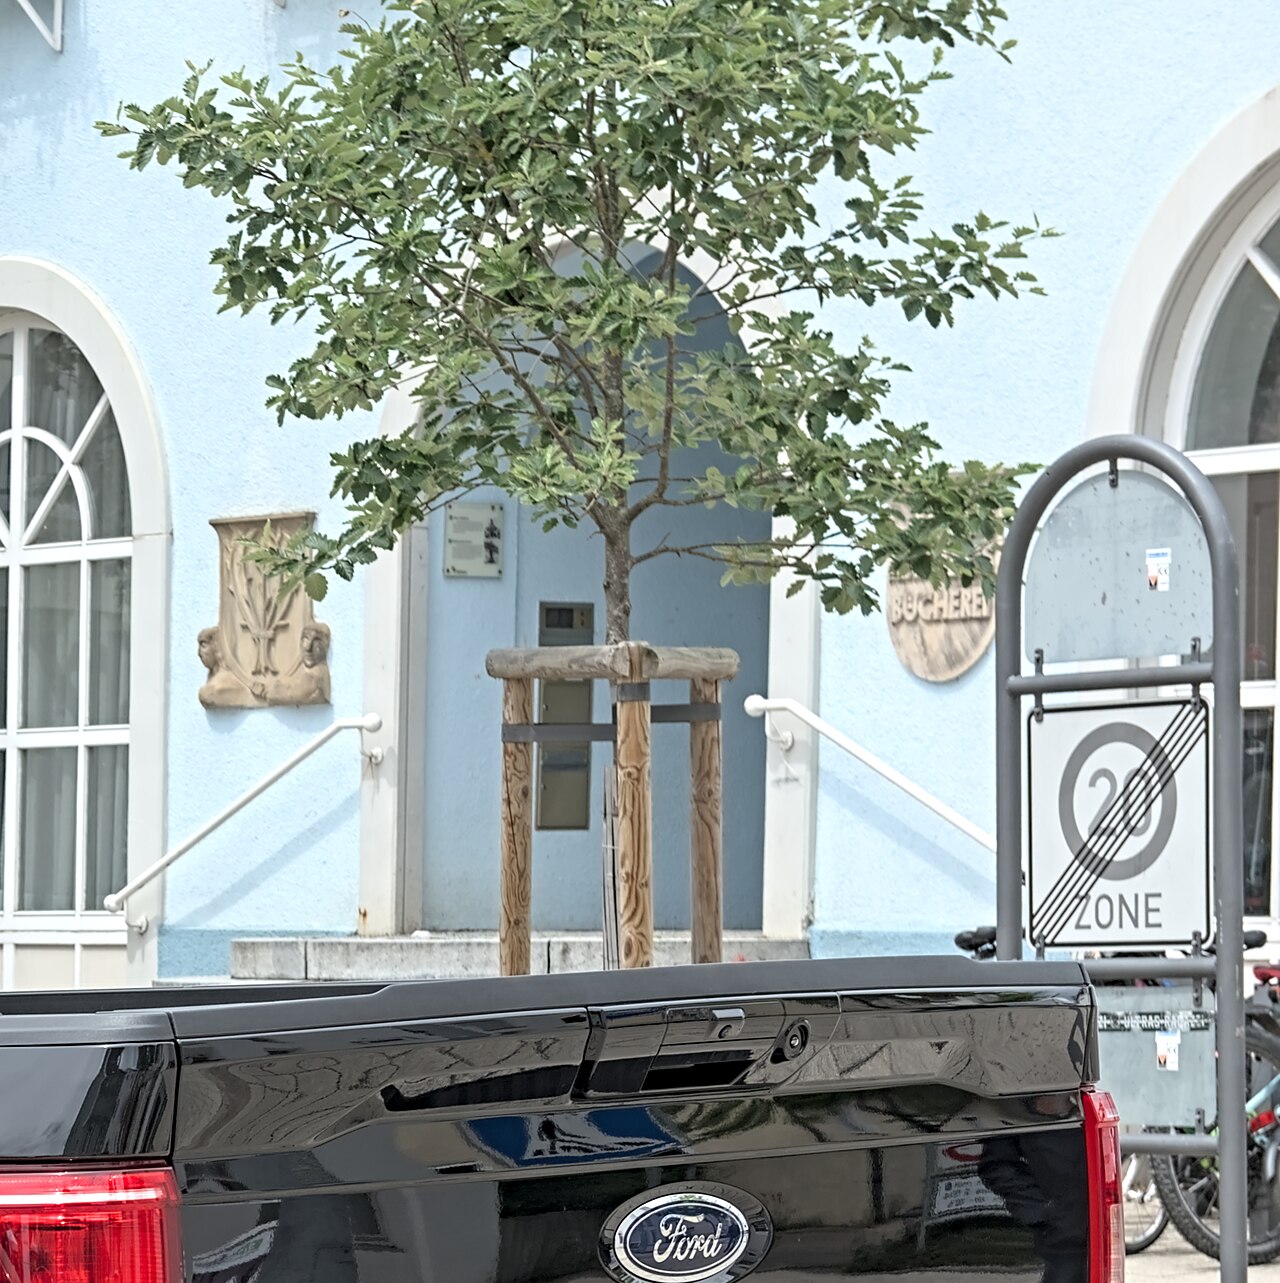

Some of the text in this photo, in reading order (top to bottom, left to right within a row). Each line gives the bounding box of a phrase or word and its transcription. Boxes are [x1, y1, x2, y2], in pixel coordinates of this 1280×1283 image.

[1088, 767, 1153, 838] 20
[1074, 893, 1162, 930] ZONE
[653, 1213, 723, 1263] Ford
